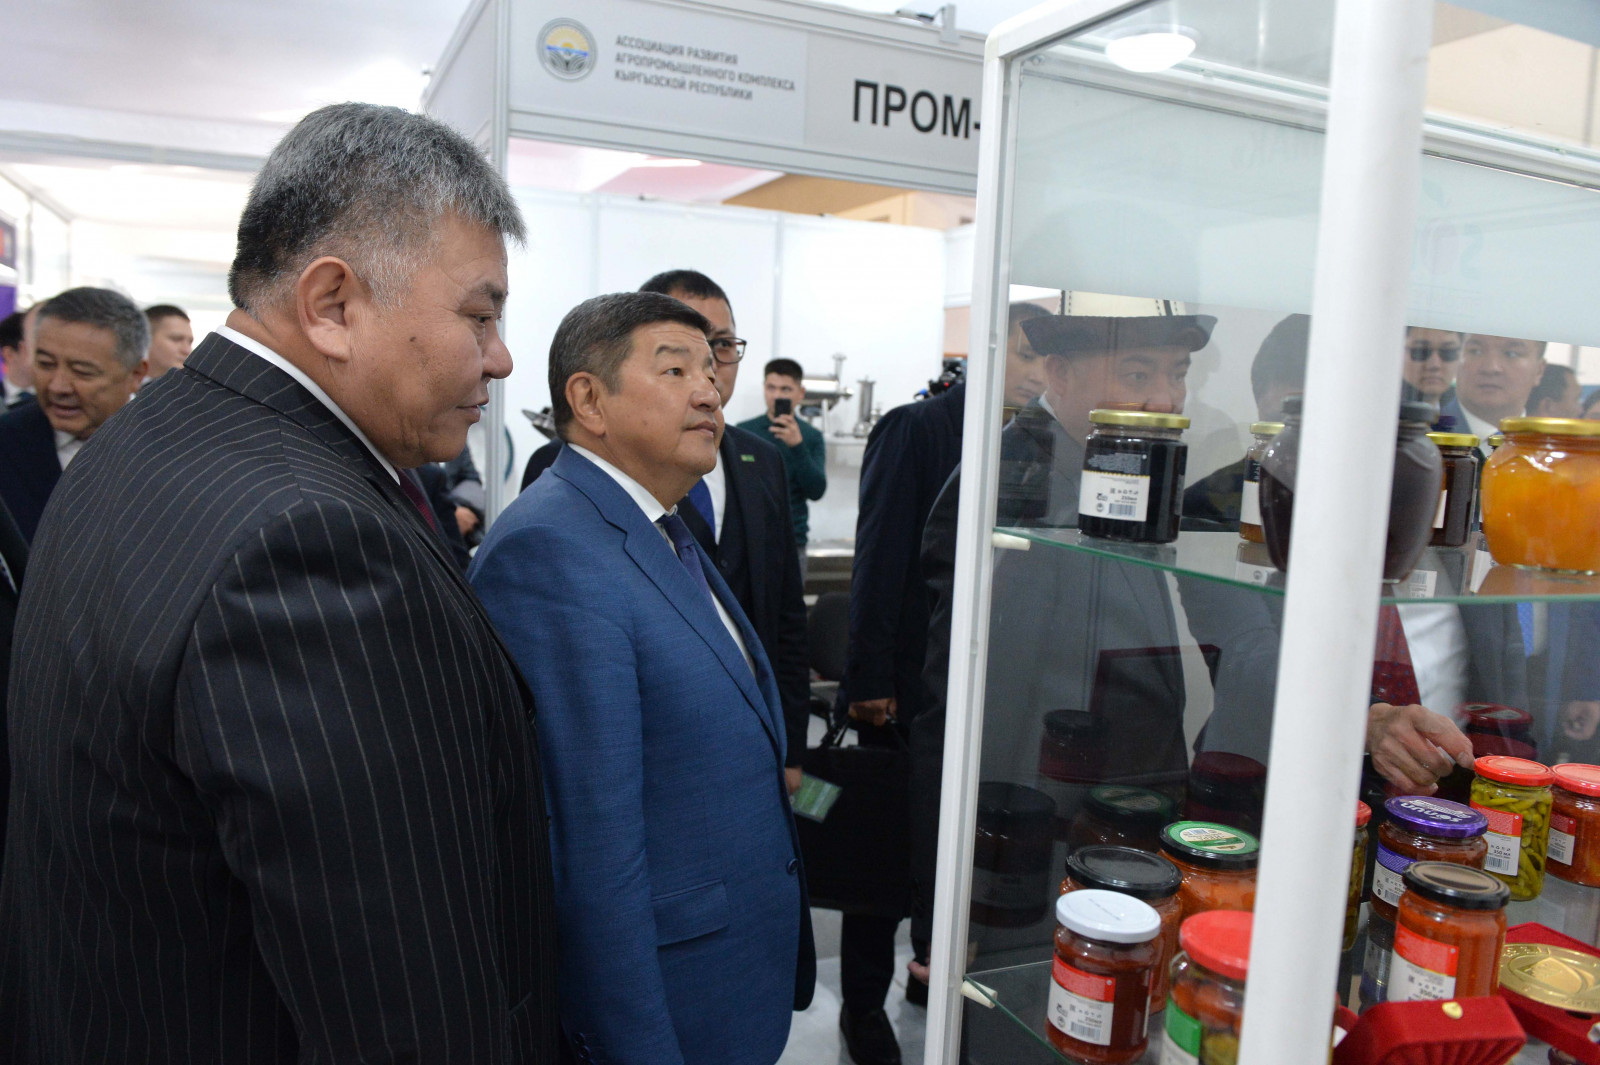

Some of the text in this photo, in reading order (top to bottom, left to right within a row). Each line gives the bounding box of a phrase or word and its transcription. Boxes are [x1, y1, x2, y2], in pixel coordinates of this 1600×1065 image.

[615, 35, 738, 65] АССОЦИАЦИЯ РАЗВИТИЯ
[614, 69, 753, 101] КЫРГЫЗСКОЙ РЕСПУБЛИКИ
[615, 52, 796, 91] АГРОПРОМЫШЛЕННОГО КОМПЛЕКСА
